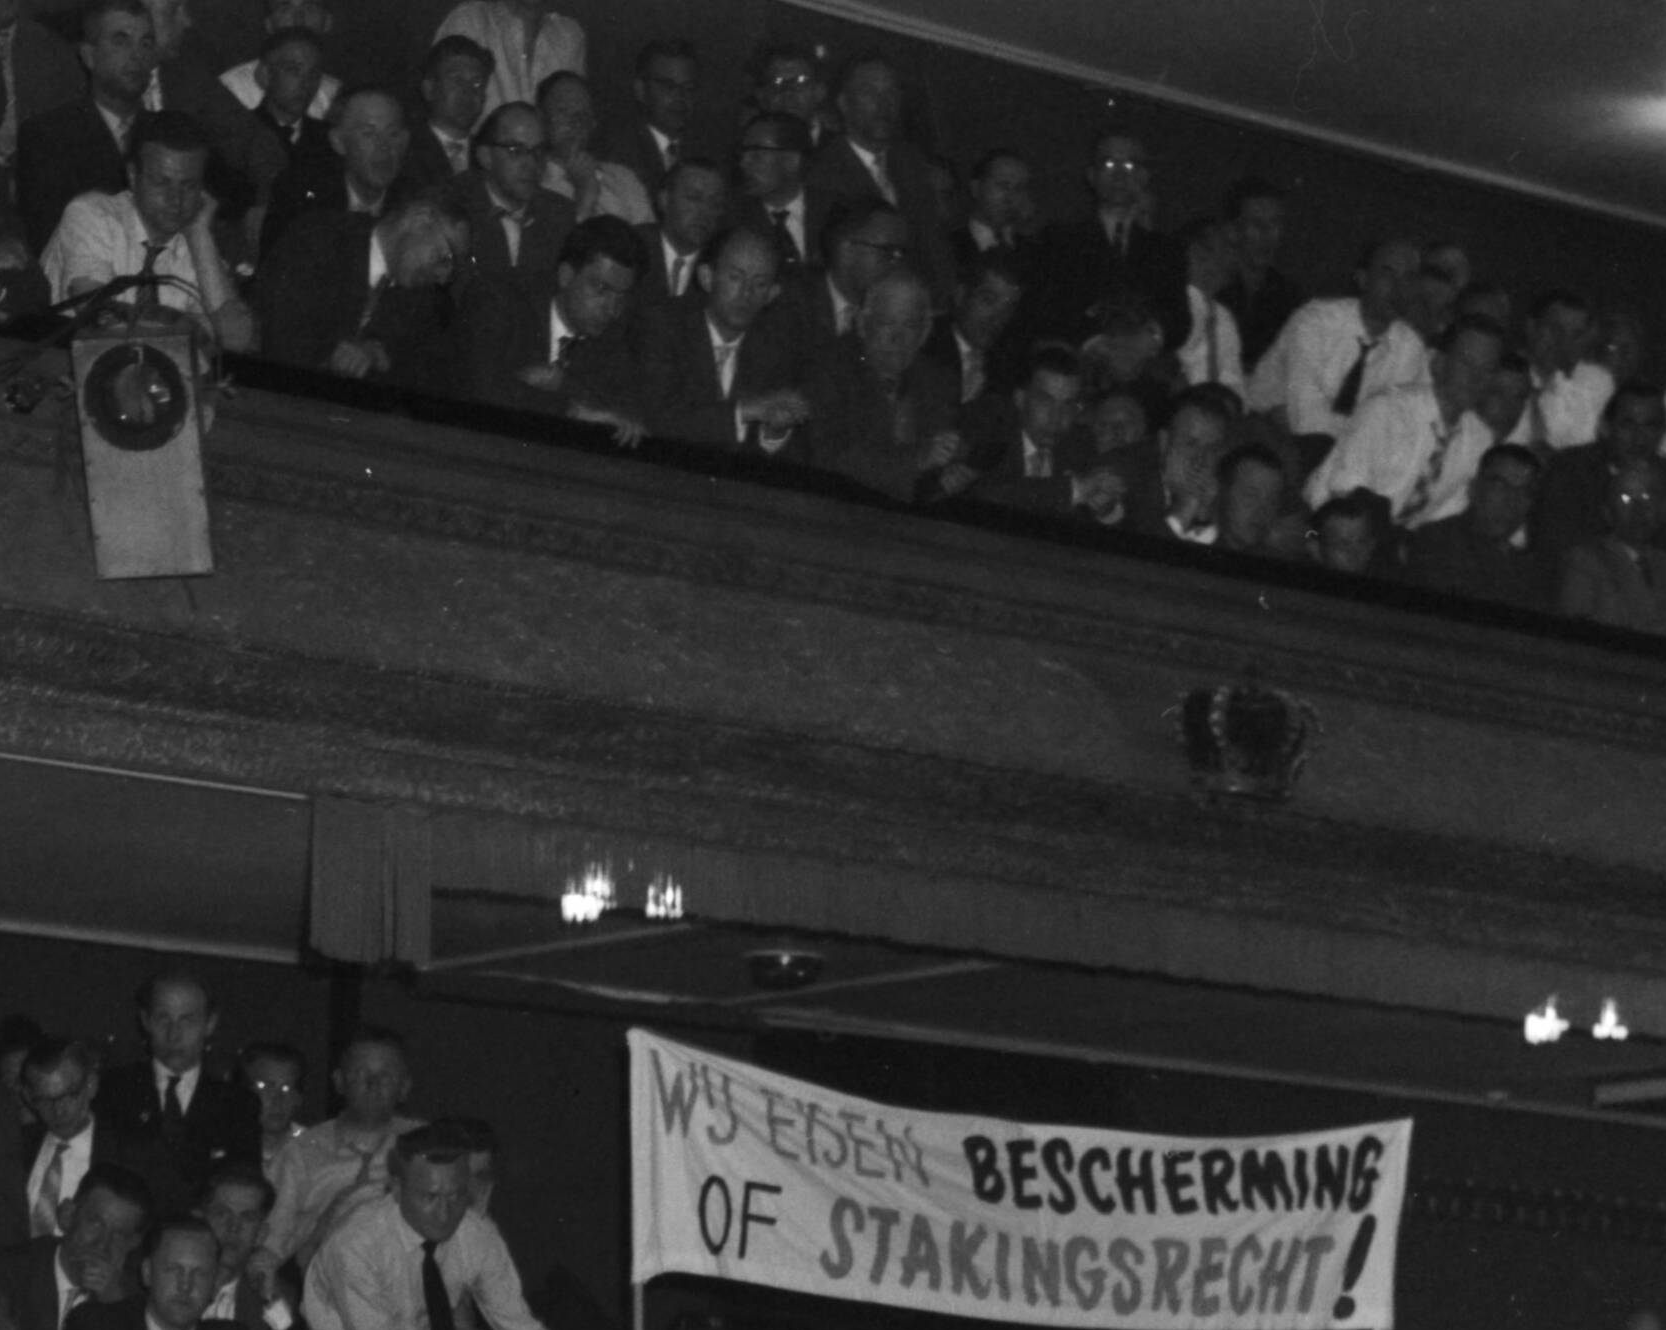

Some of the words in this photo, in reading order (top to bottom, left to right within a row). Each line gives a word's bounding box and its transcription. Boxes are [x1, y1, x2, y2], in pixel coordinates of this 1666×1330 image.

[963, 1135, 1384, 1216] BESCHERMING
[698, 1174, 783, 1260] OF
[820, 1195, 1377, 1321] STAKINGSRECHT!
